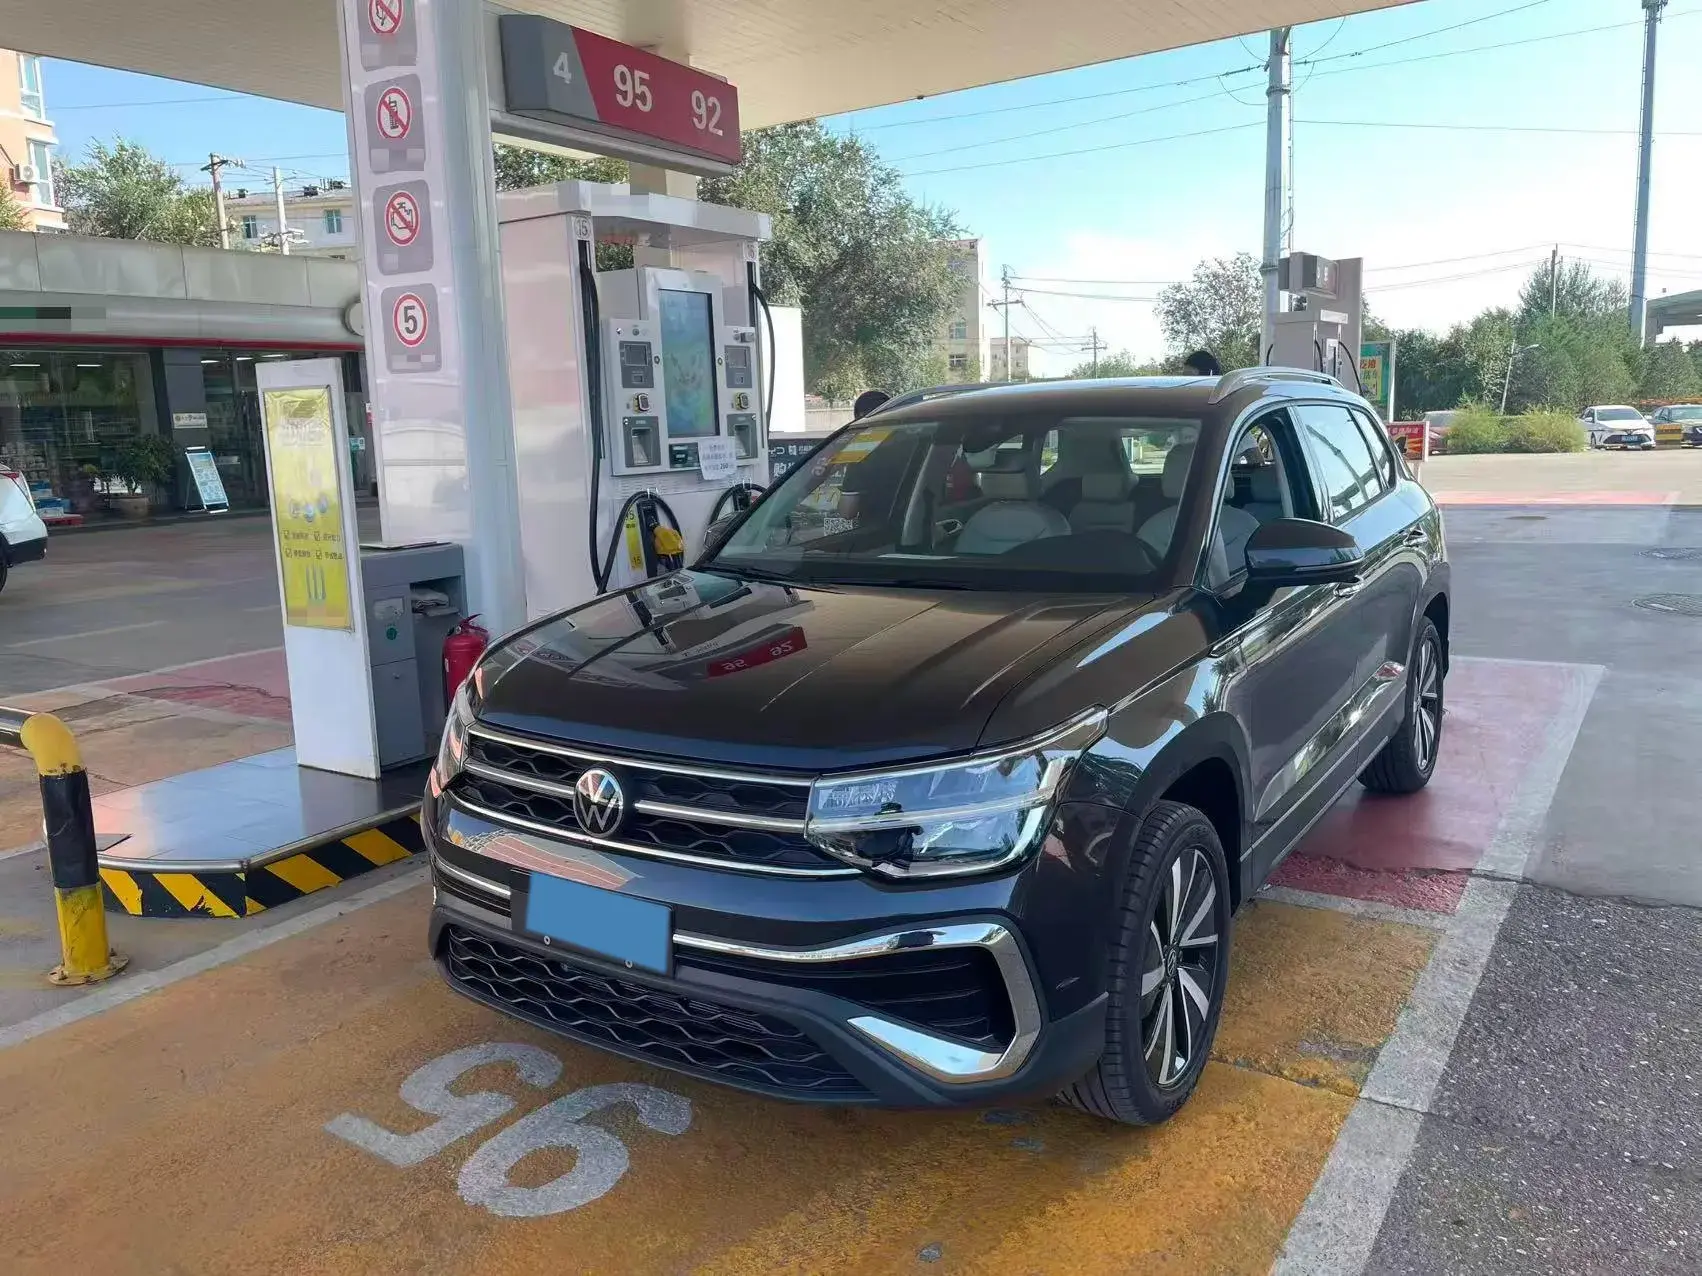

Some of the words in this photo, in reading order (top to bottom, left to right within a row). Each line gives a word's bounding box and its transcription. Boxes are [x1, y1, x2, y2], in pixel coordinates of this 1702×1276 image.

[552, 52, 572, 85] 4
[613, 64, 653, 112] 95
[691, 90, 723, 137] 92
[403, 305, 419, 335] 5
[322, 1041, 693, 1218] 95
